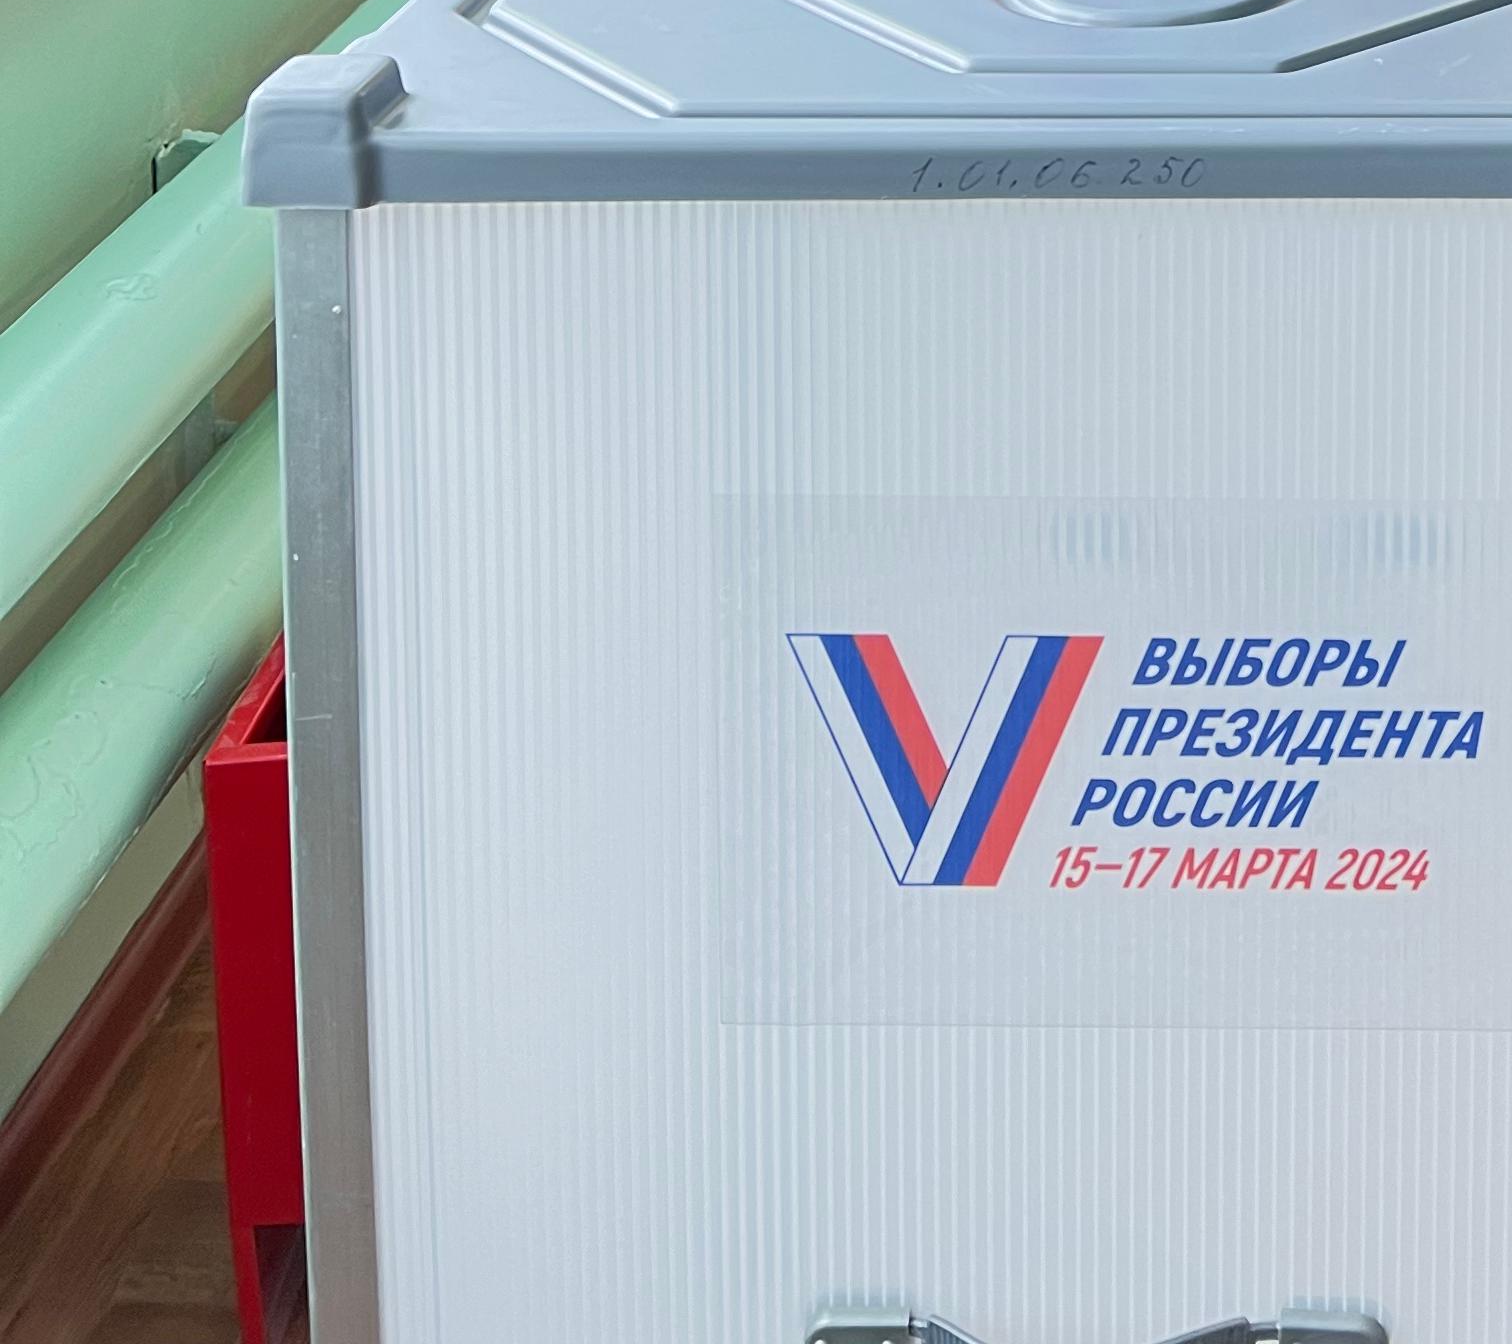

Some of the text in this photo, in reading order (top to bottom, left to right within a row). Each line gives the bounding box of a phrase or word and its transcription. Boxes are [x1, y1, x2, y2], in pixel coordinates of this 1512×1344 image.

[1131, 636, 1408, 688] ВЫБОРЫ
[1100, 706, 1485, 767] ПРЕЗИДЕНТА
[1071, 777, 1320, 829] РОССИИ
[1171, 847, 1318, 890] МАРТА
[1324, 848, 1429, 890] 2024
